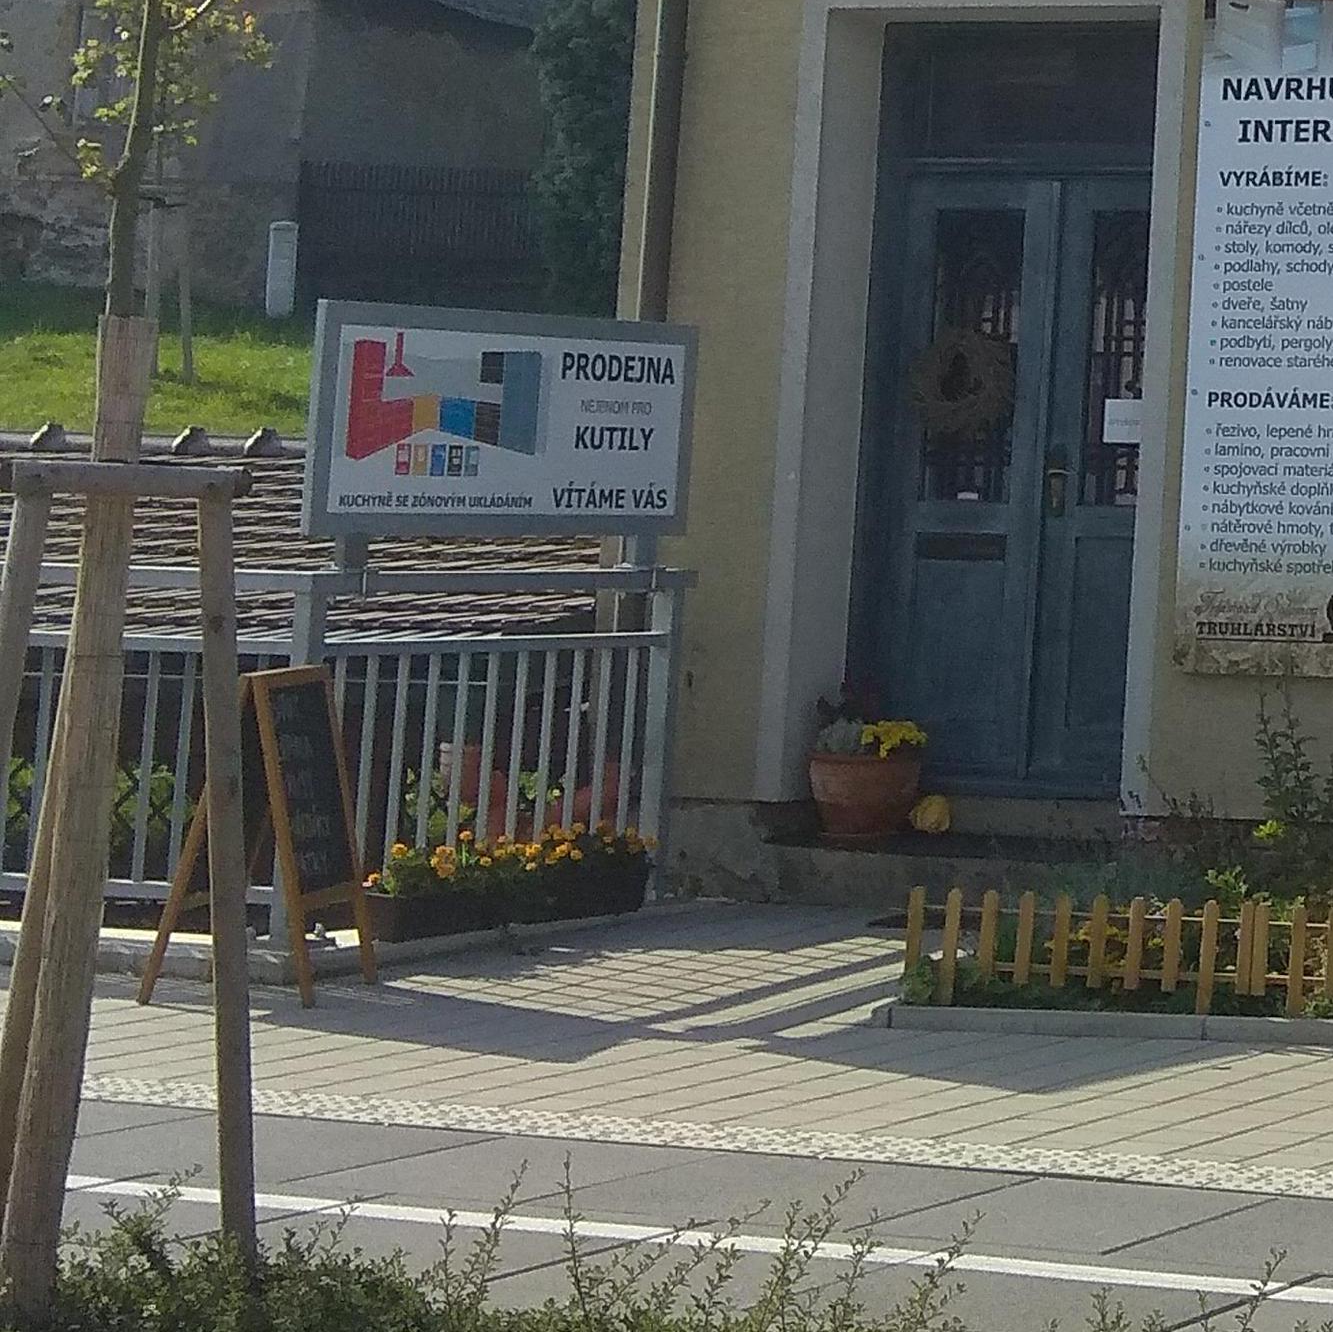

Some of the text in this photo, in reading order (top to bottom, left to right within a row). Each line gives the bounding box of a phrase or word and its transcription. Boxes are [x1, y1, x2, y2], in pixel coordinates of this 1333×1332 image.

[1219, 166, 1329, 187] VYRÁBÍME:
[1226, 202, 1284, 217] kuchyně
[1288, 202, 1333, 216] včetně
[1225, 221, 1271, 236] nářezy
[1275, 221, 1312, 236] dílců,
[1225, 240, 1259, 255] stoly,
[1265, 240, 1322, 256] komody,
[1224, 259, 1281, 274] podlahy,
[1223, 279, 1273, 293] postele
[1222, 297, 1307, 313] dveře, šatny
[1221, 314, 1303, 331] kancelářský
[1281, 337, 1333, 351] pergoly
[561, 351, 675, 385] PRODEJNA
[1219, 356, 1282, 368] renovace
[632, 400, 652, 415] PRO
[574, 425, 655, 451] KUTILY
[1215, 423, 1261, 440] řezivo,
[1266, 425, 1313, 440] lepené
[1214, 444, 1264, 459] lamino,
[1270, 444, 1330, 459] pracovní
[1214, 462, 1278, 479] spojovací
[553, 481, 667, 510] VÍTÁME VÁS
[1213, 481, 1286, 498] kuchyňské
[395, 495, 408, 507] SE
[1211, 501, 1333, 517] nábytkové kování
[1211, 520, 1273, 534] nátěrové
[1277, 523, 1323, 537] hmoty,
[1210, 540, 1327, 556] dřevěné výrobky
[1208, 558, 1282, 575] kuchyňské
